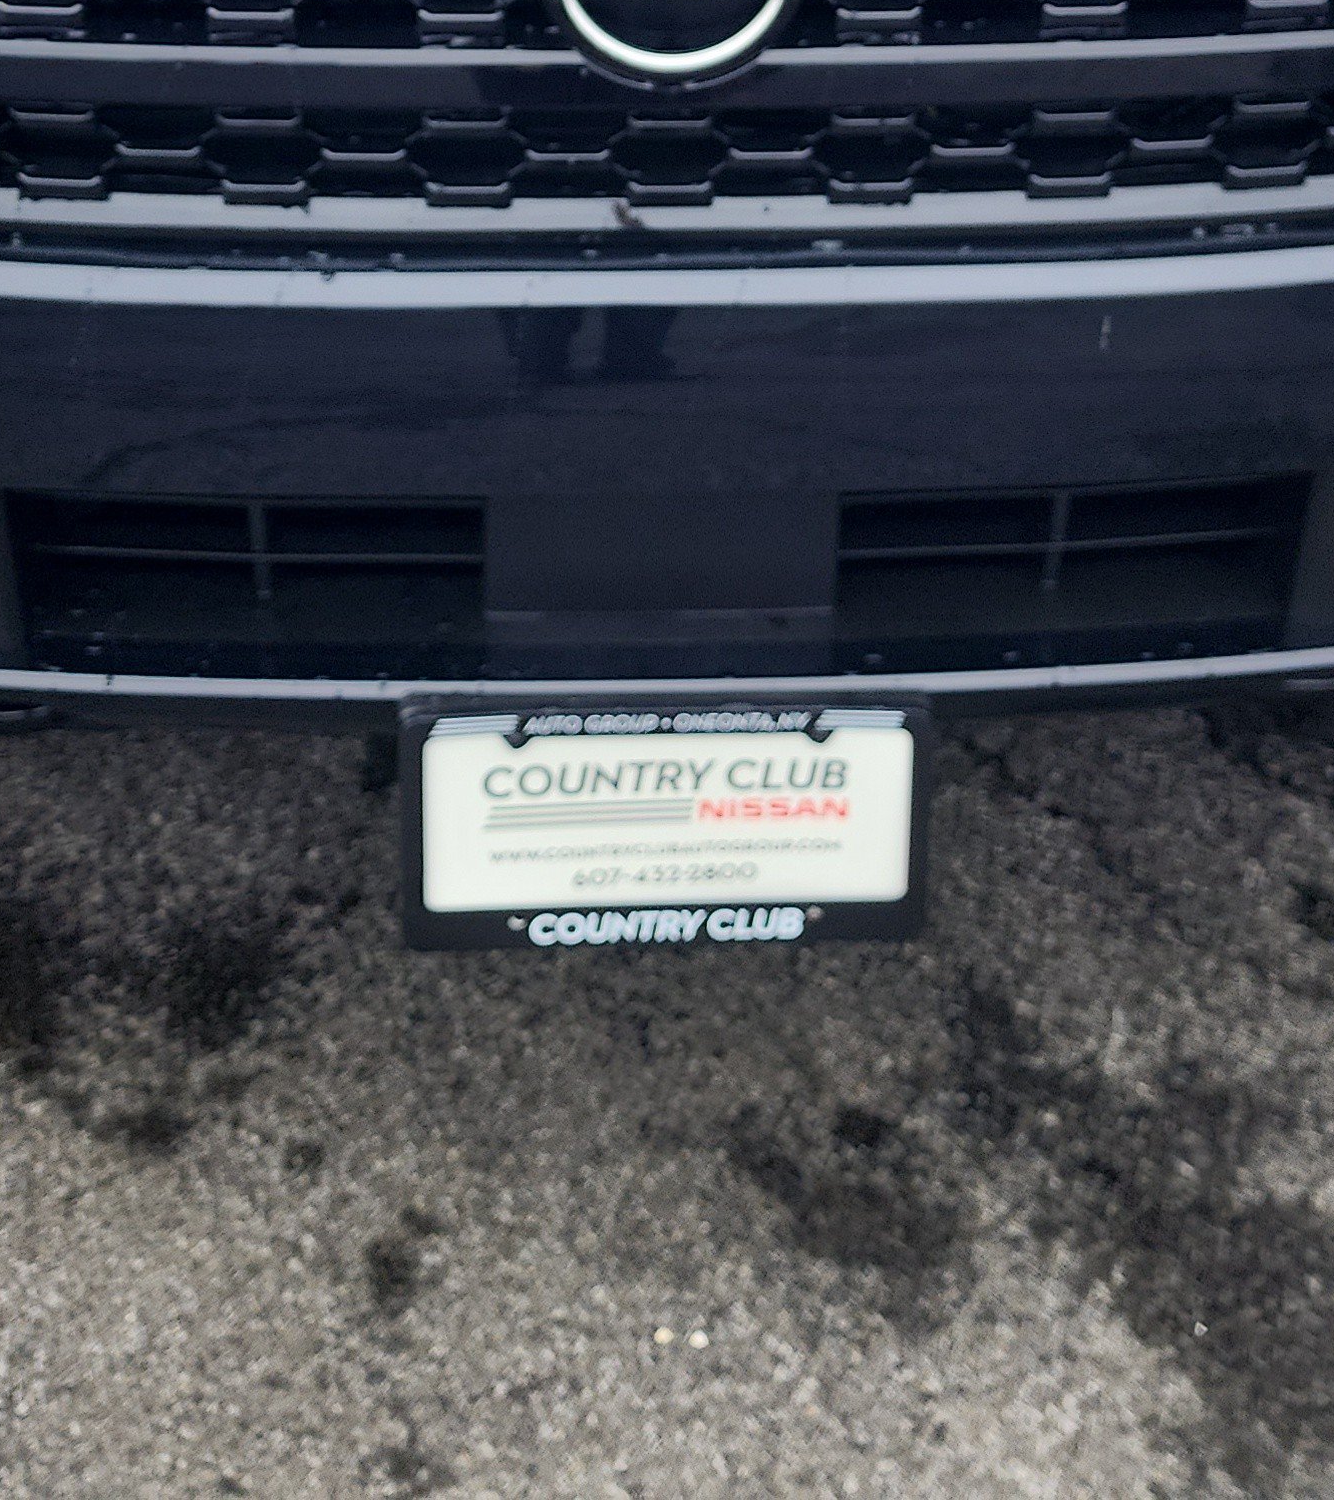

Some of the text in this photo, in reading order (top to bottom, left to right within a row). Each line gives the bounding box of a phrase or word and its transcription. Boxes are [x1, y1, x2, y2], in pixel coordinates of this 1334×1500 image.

[523, 714, 583, 735] AUTO
[584, 713, 660, 734] GROUP
[482, 758, 848, 799] COUNTRY CLUB
[698, 798, 849, 820] NISSAN
[528, 906, 806, 946] COUNTRY CLUB
